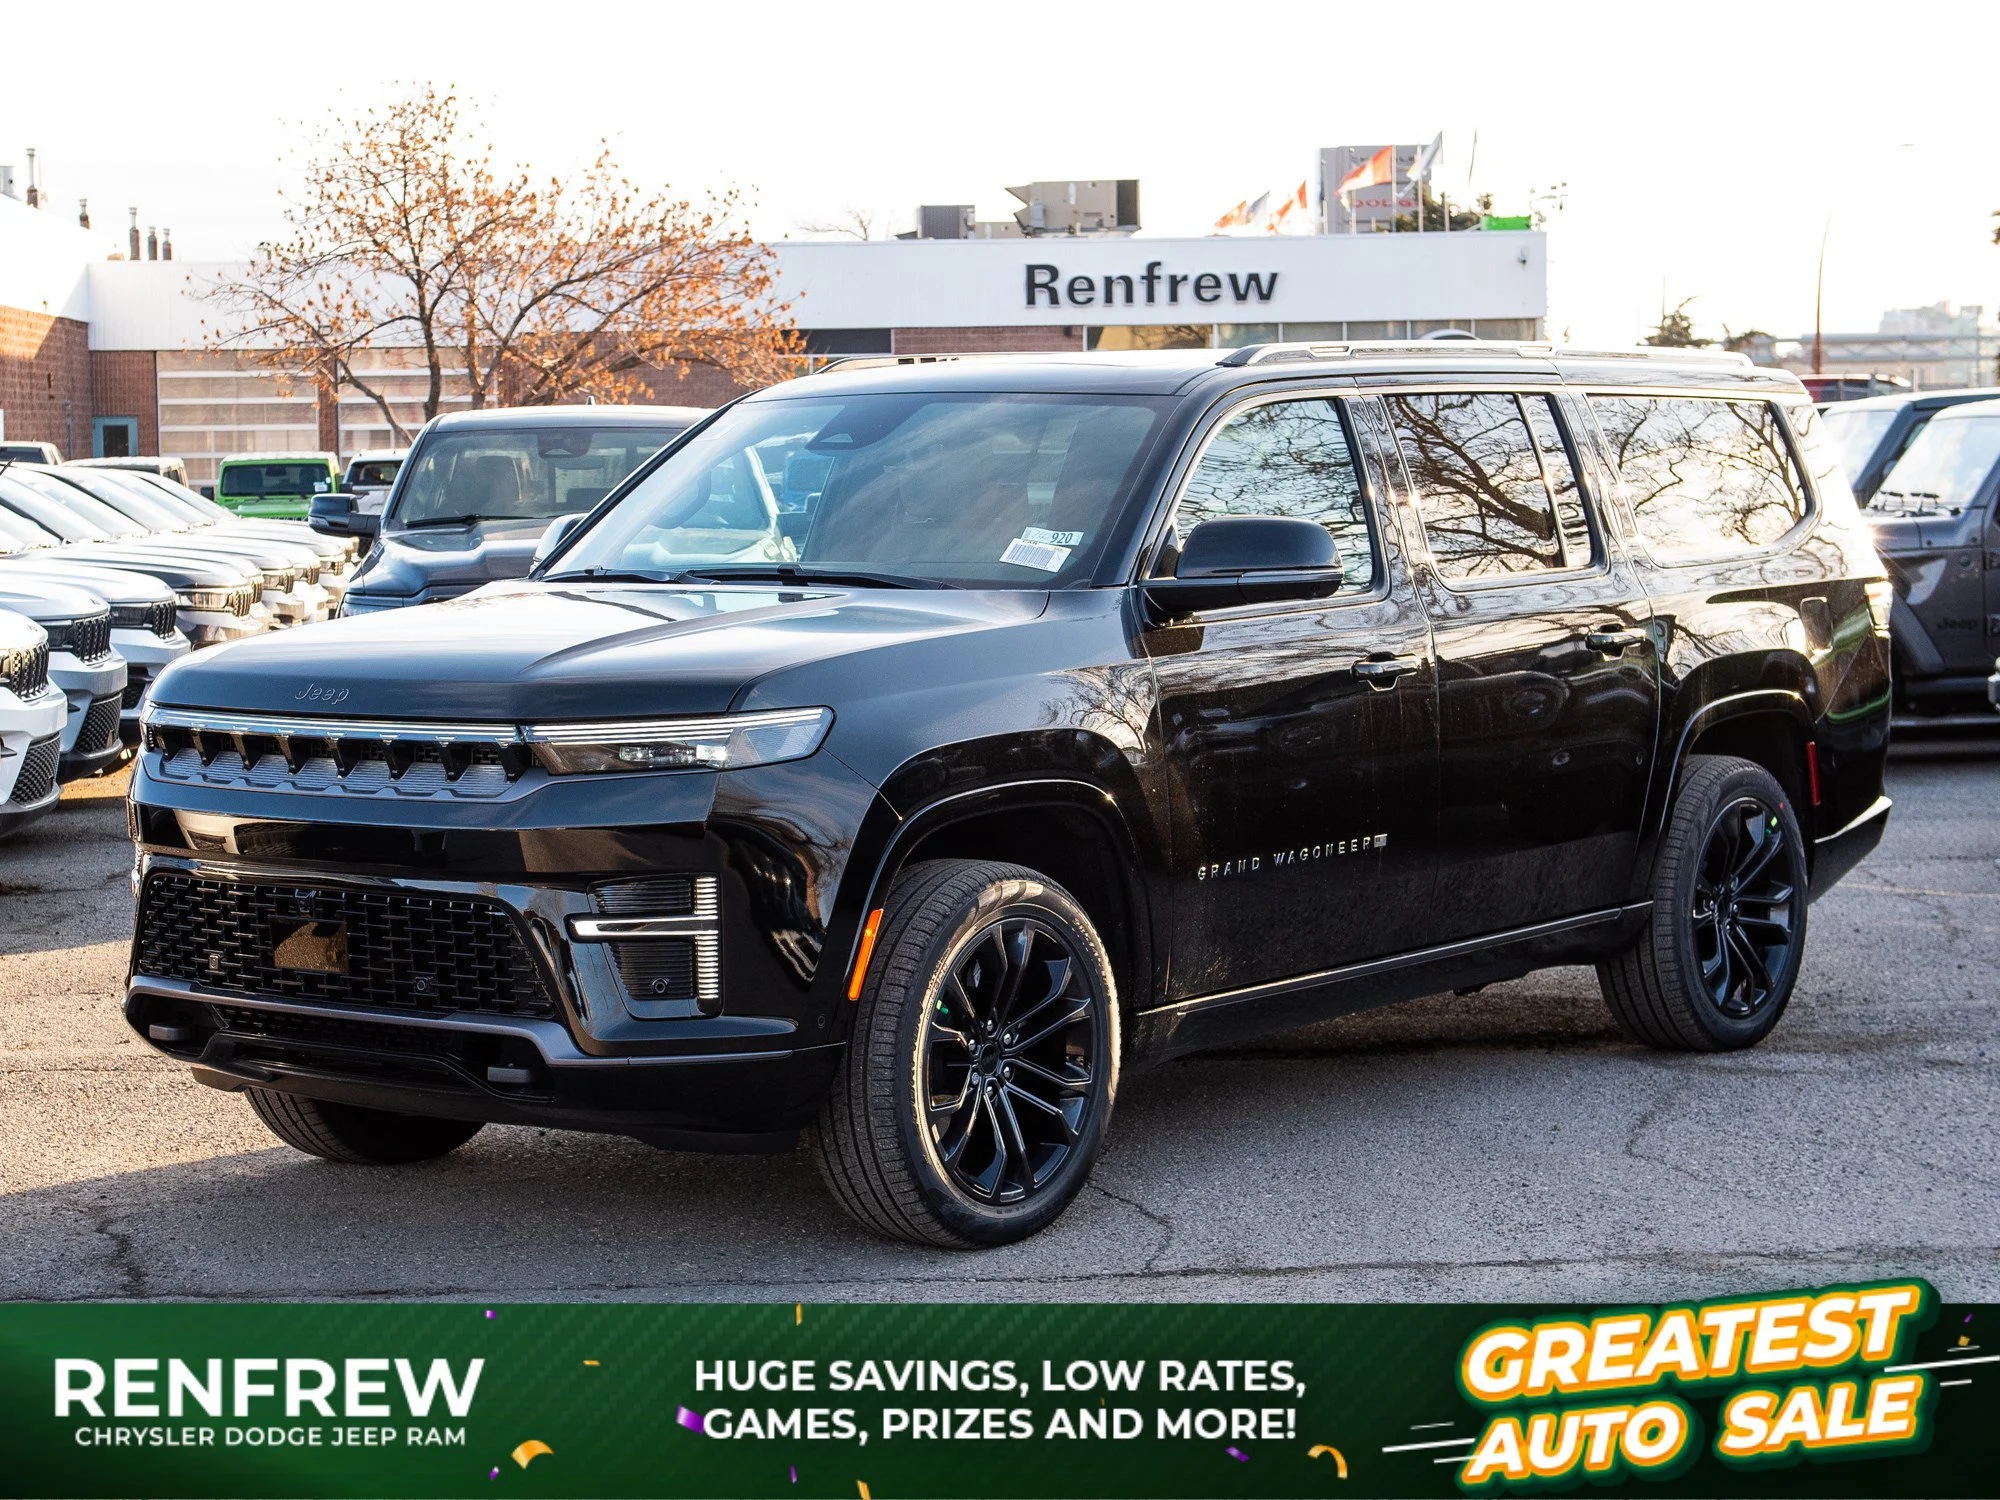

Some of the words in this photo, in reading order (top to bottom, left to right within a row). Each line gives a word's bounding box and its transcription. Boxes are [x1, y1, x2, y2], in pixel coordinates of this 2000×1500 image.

[1025, 261, 1278, 306] Renfrew
[294, 683, 350, 705] Jeep
[1197, 856, 1261, 881] GRAND
[1273, 836, 1371, 867] WAGONEER
